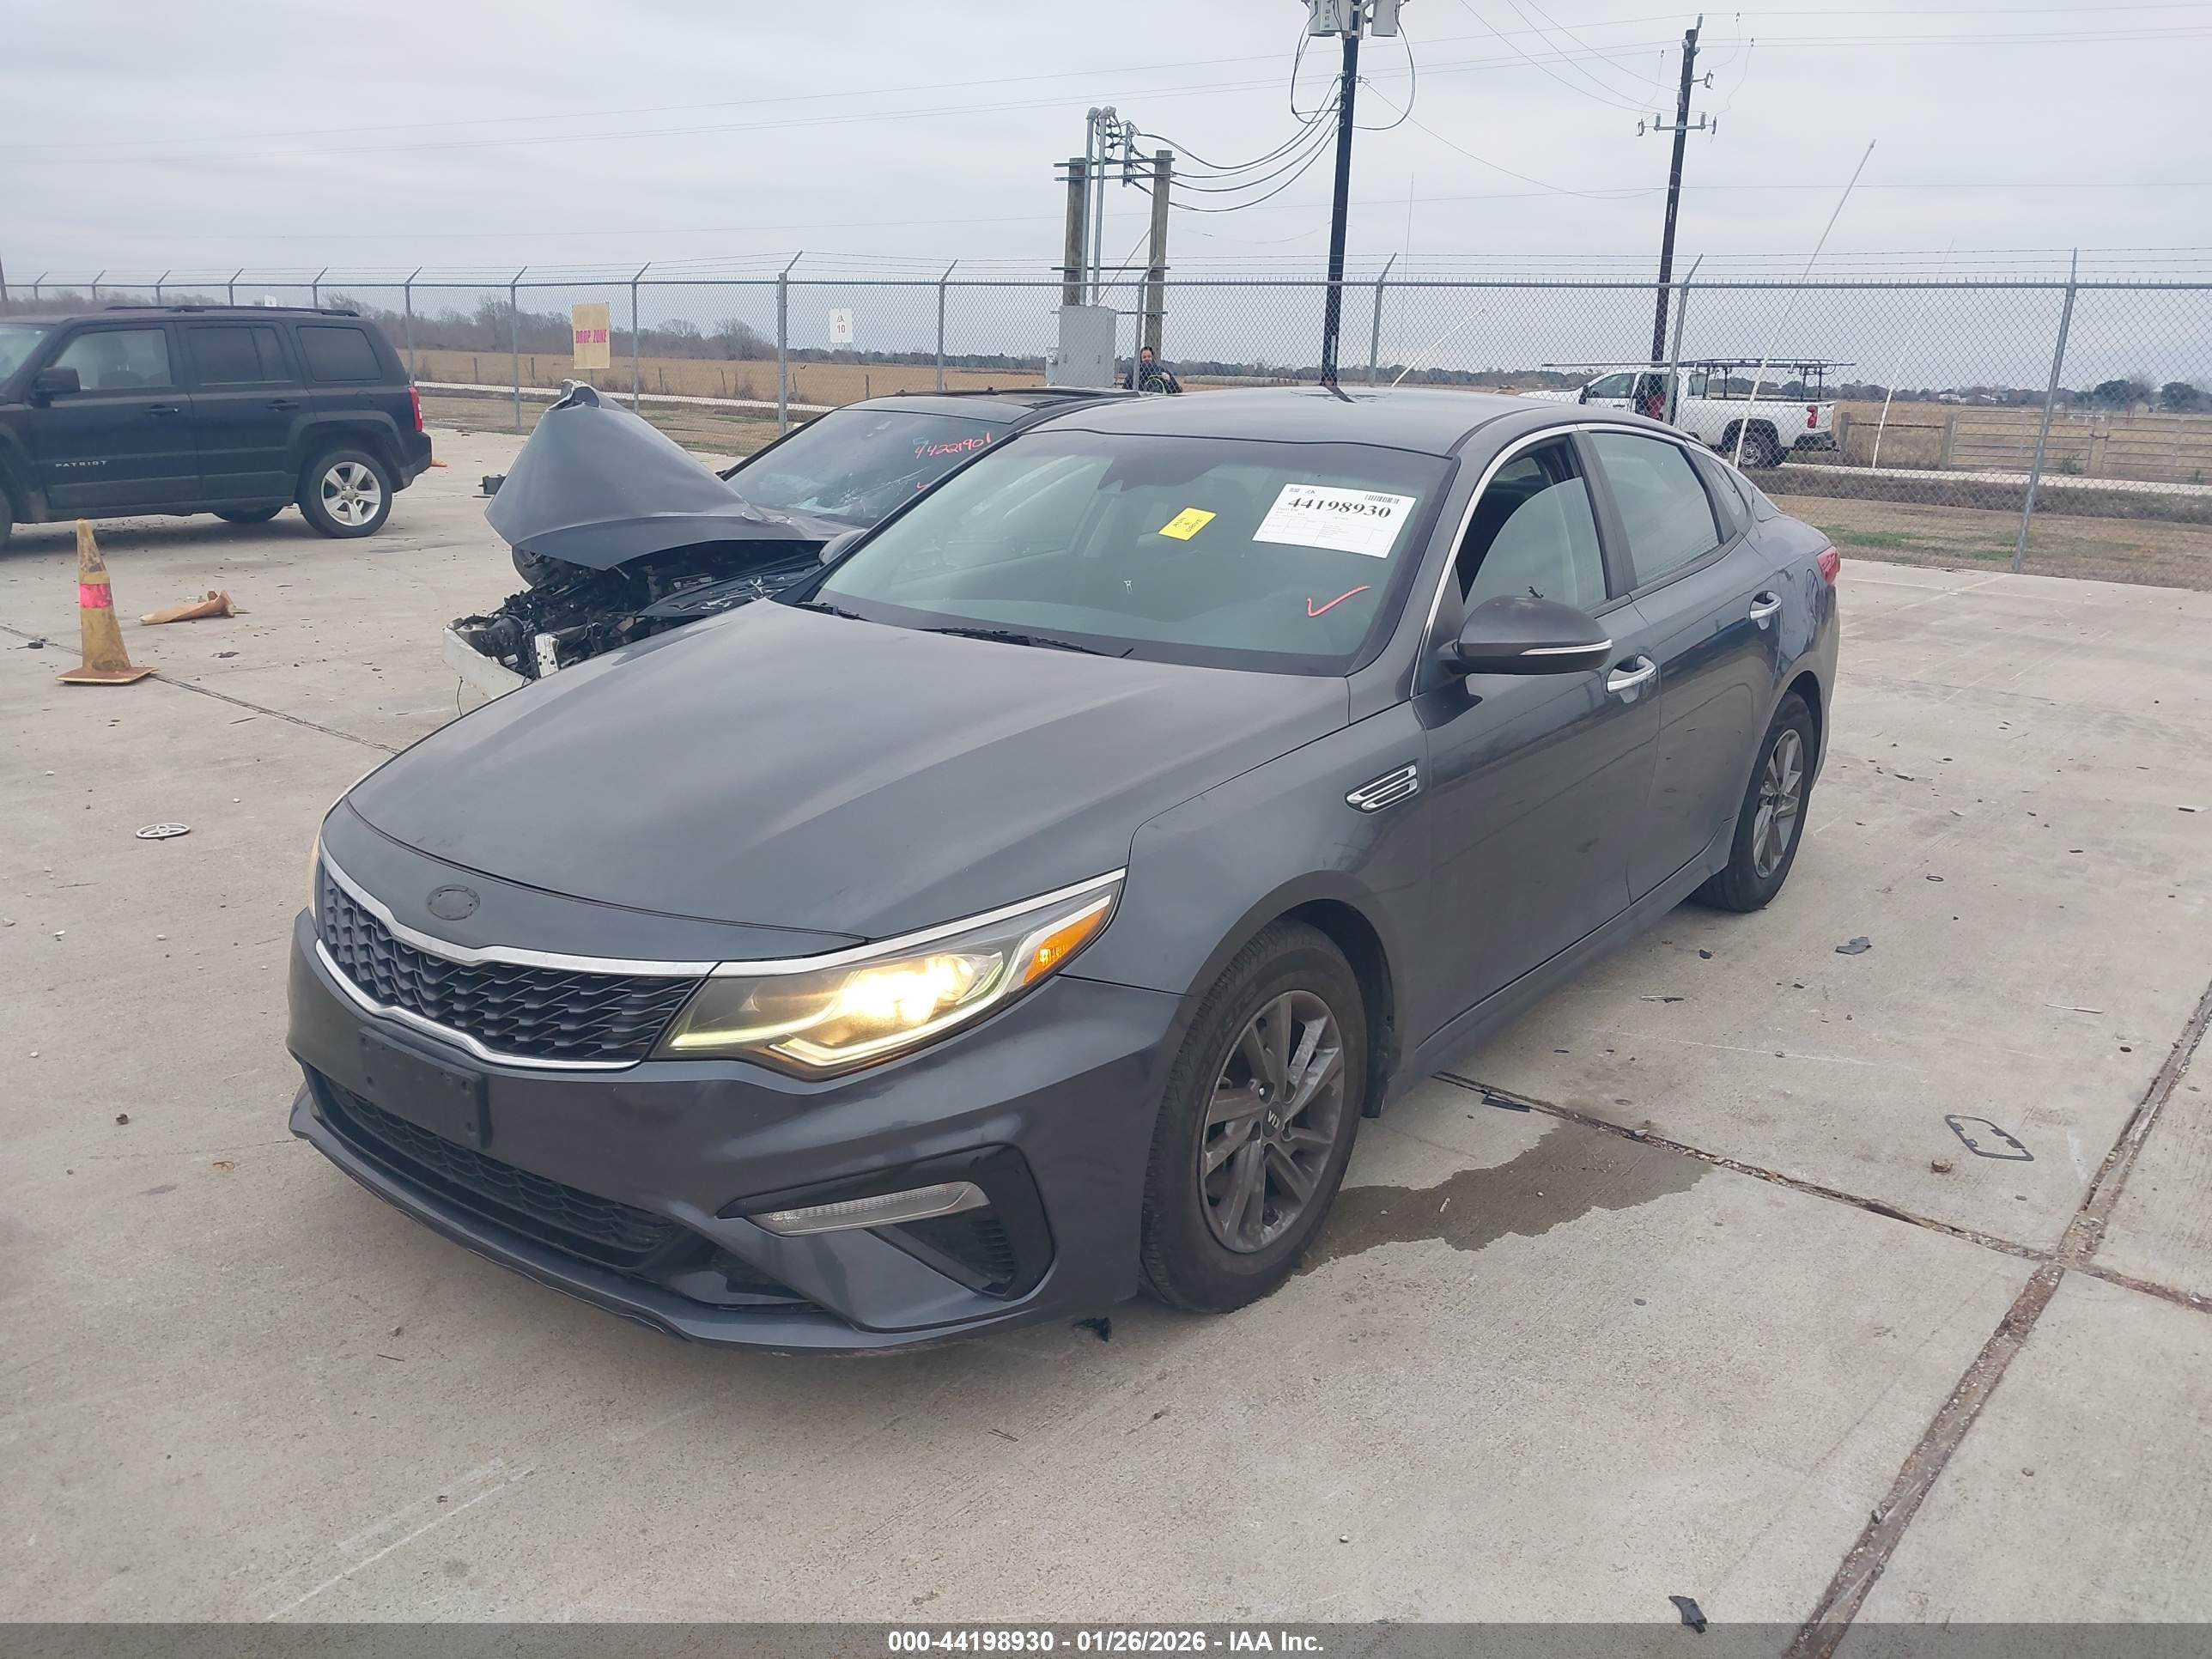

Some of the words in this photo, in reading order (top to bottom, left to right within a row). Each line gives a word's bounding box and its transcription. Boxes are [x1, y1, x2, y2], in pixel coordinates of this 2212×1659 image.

[575, 330, 591, 343] DROP
[593, 329, 607, 343] ZONE
[837, 325, 846, 334] 10
[1287, 497, 1392, 519] 44198930
